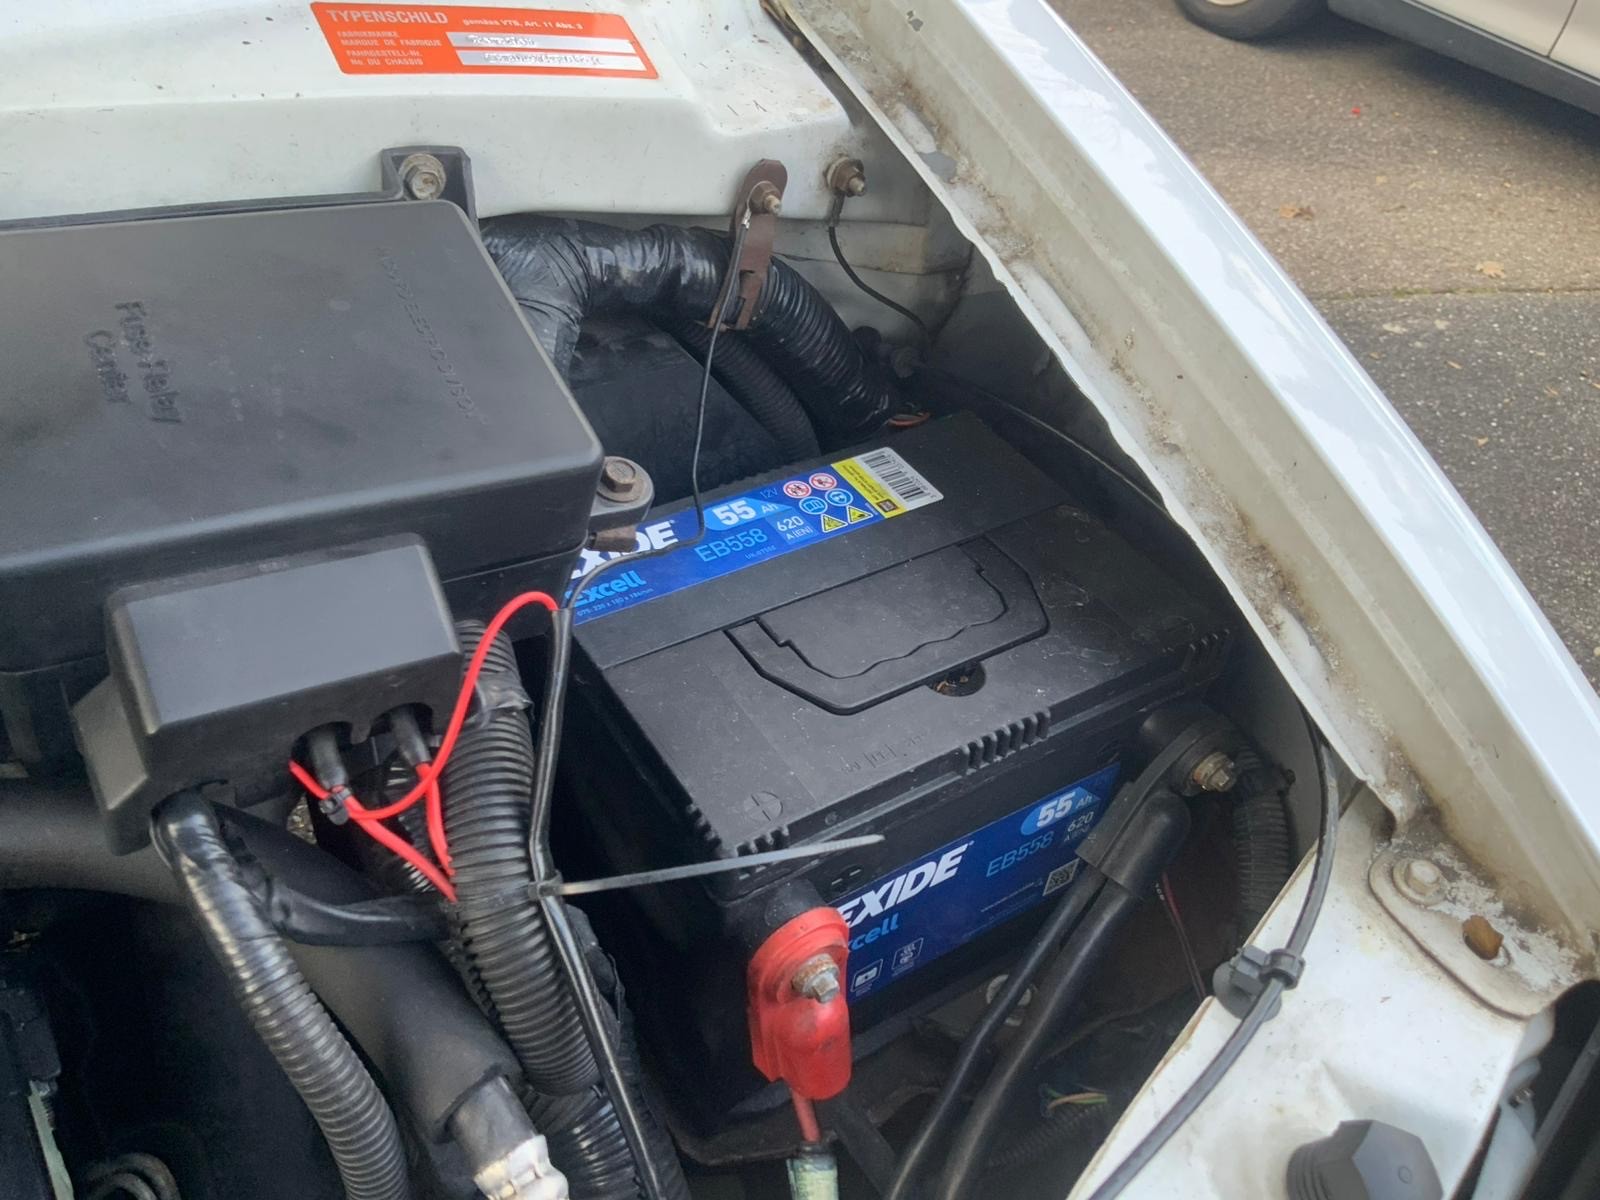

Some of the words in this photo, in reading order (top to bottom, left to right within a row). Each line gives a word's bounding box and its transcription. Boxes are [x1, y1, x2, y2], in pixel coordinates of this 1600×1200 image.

[326, 9, 449, 24] TYPENSCHILD
[760, 487, 779, 499] 12V
[712, 500, 757, 526] 55
[761, 502, 778, 514] Ah
[776, 515, 805, 532] 620
[693, 528, 768, 562] EB558
[1037, 791, 1076, 828] 55
[1067, 811, 1095, 832] 620
[985, 830, 1055, 878] EB558
